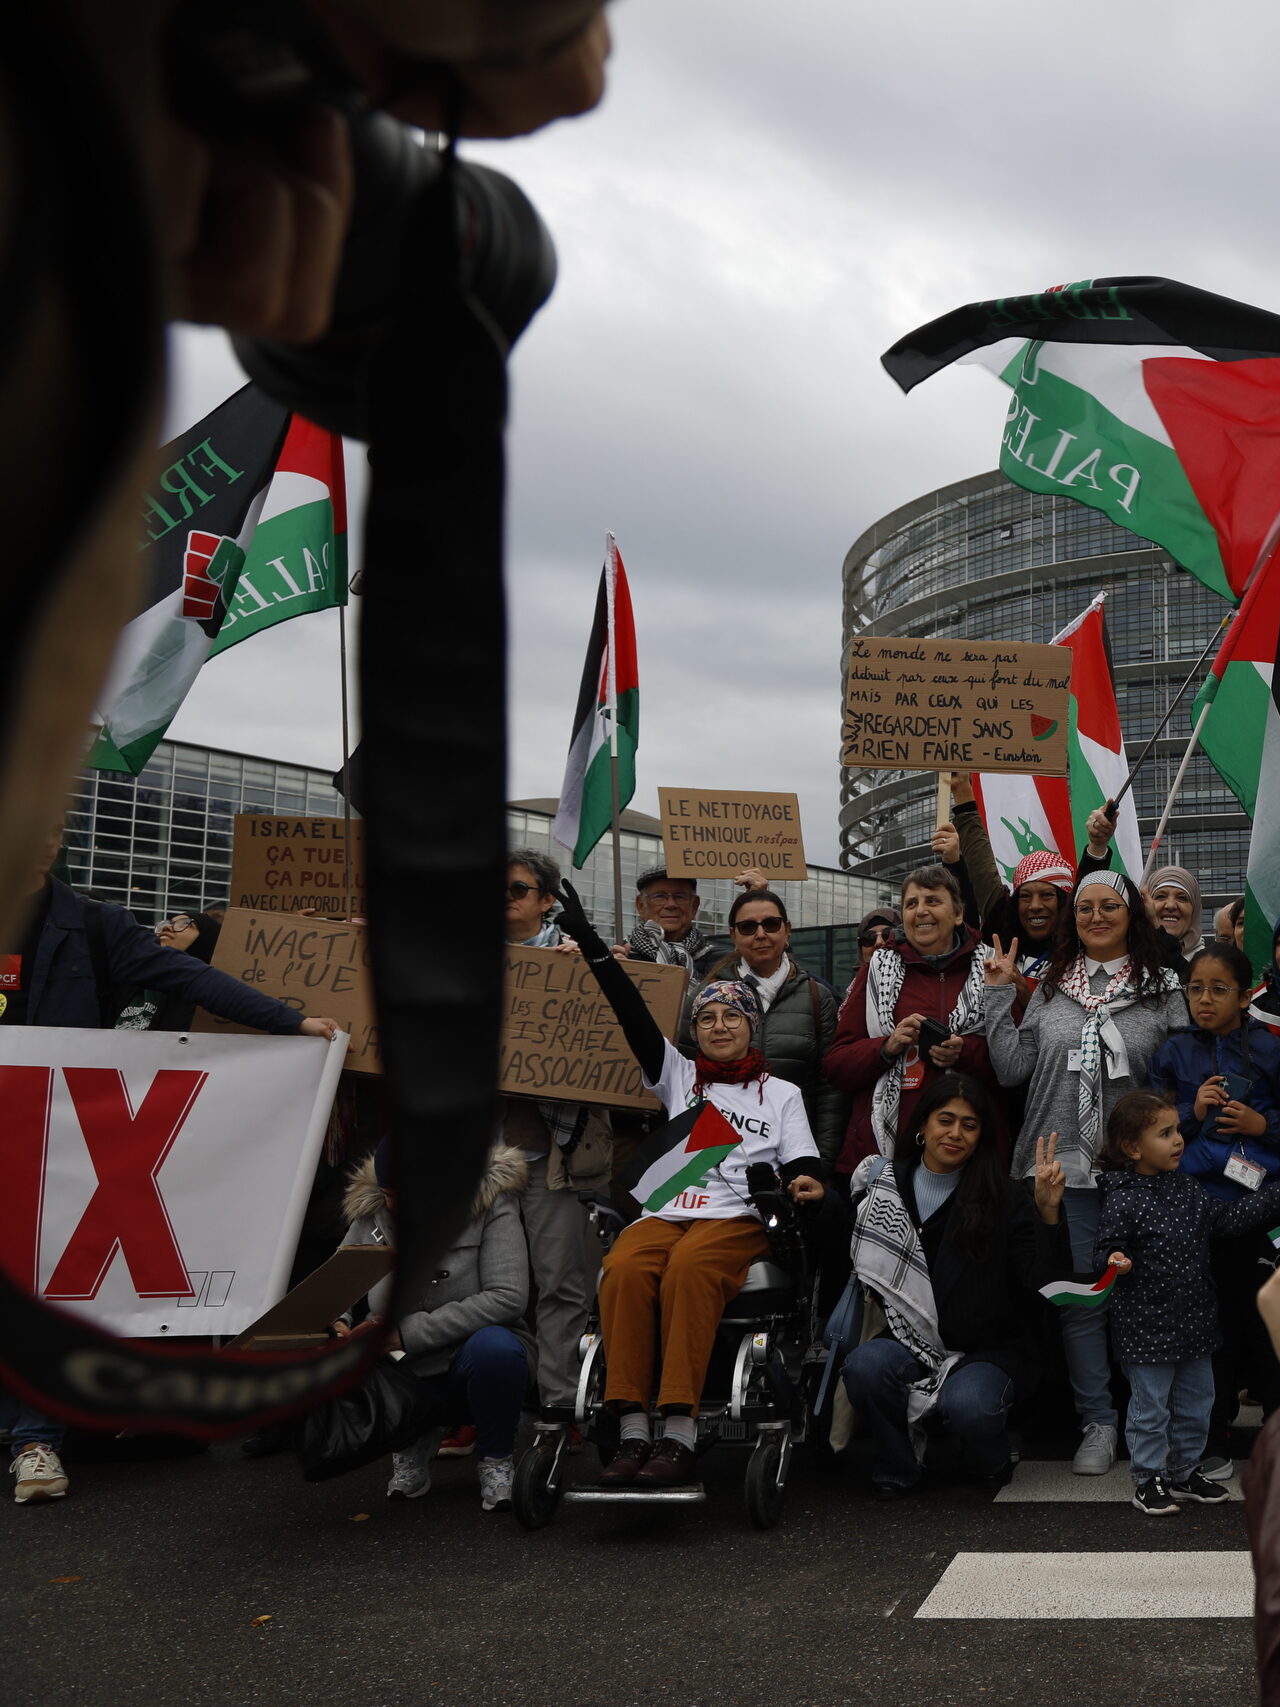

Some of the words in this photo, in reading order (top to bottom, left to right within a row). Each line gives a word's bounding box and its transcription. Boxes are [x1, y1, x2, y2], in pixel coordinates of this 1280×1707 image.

[852, 640, 871, 658] Le
[878, 644, 926, 660] monde
[934, 652, 951, 662] ne
[961, 653, 988, 663] sera
[992, 653, 1018, 668] pas
[896, 672, 925, 689] par
[931, 674, 958, 683] ceux
[963, 672, 986, 689] qui
[989, 669, 1017, 690] font
[1023, 671, 1042, 687] du
[1046, 675, 1071, 689] mal
[895, 693, 918, 707] PAR
[929, 694, 962, 709] CEUX
[1010, 699, 1034, 710] LES
[863, 713, 961, 738] REGARDENT
[972, 719, 1014, 739] SANS
[862, 739, 909, 761] RIEN
[668, 800, 691, 816] LE
[699, 801, 794, 821] NETTOYAGE
[251, 819, 344, 839] ISRAËL
[670, 825, 752, 843] ETHNIQUE
[779, 838, 798, 847] pas
[266, 845, 295, 866] ÇA
[683, 848, 794, 869] ÉCOLOGIQUE
[265, 870, 293, 890] ÇA
[239, 894, 277, 911] AVEC
[241, 959, 266, 983] de
